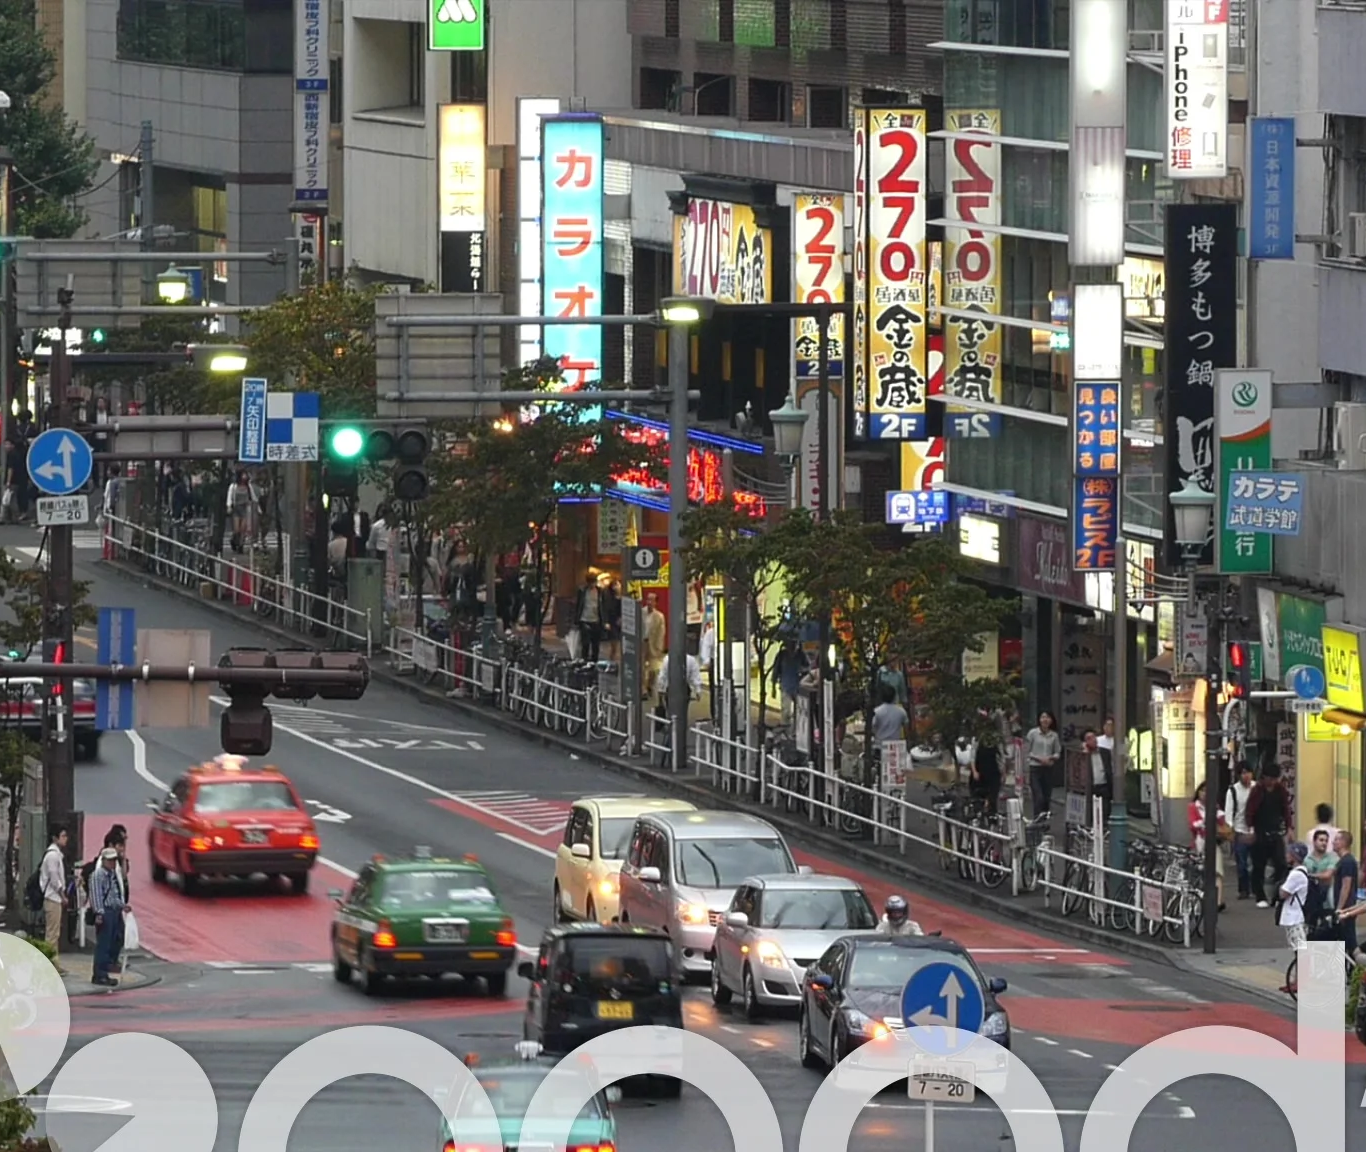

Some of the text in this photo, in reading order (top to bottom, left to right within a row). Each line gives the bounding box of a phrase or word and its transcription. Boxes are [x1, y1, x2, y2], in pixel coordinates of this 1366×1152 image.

[1187, 225, 1215, 385] 博多もつ鍋
[879, 414, 917, 438] 2F
[268, 444, 316, 460] 時差式
[1233, 475, 1299, 503] カラテ
[1229, 506, 1299, 530] 武道学館
